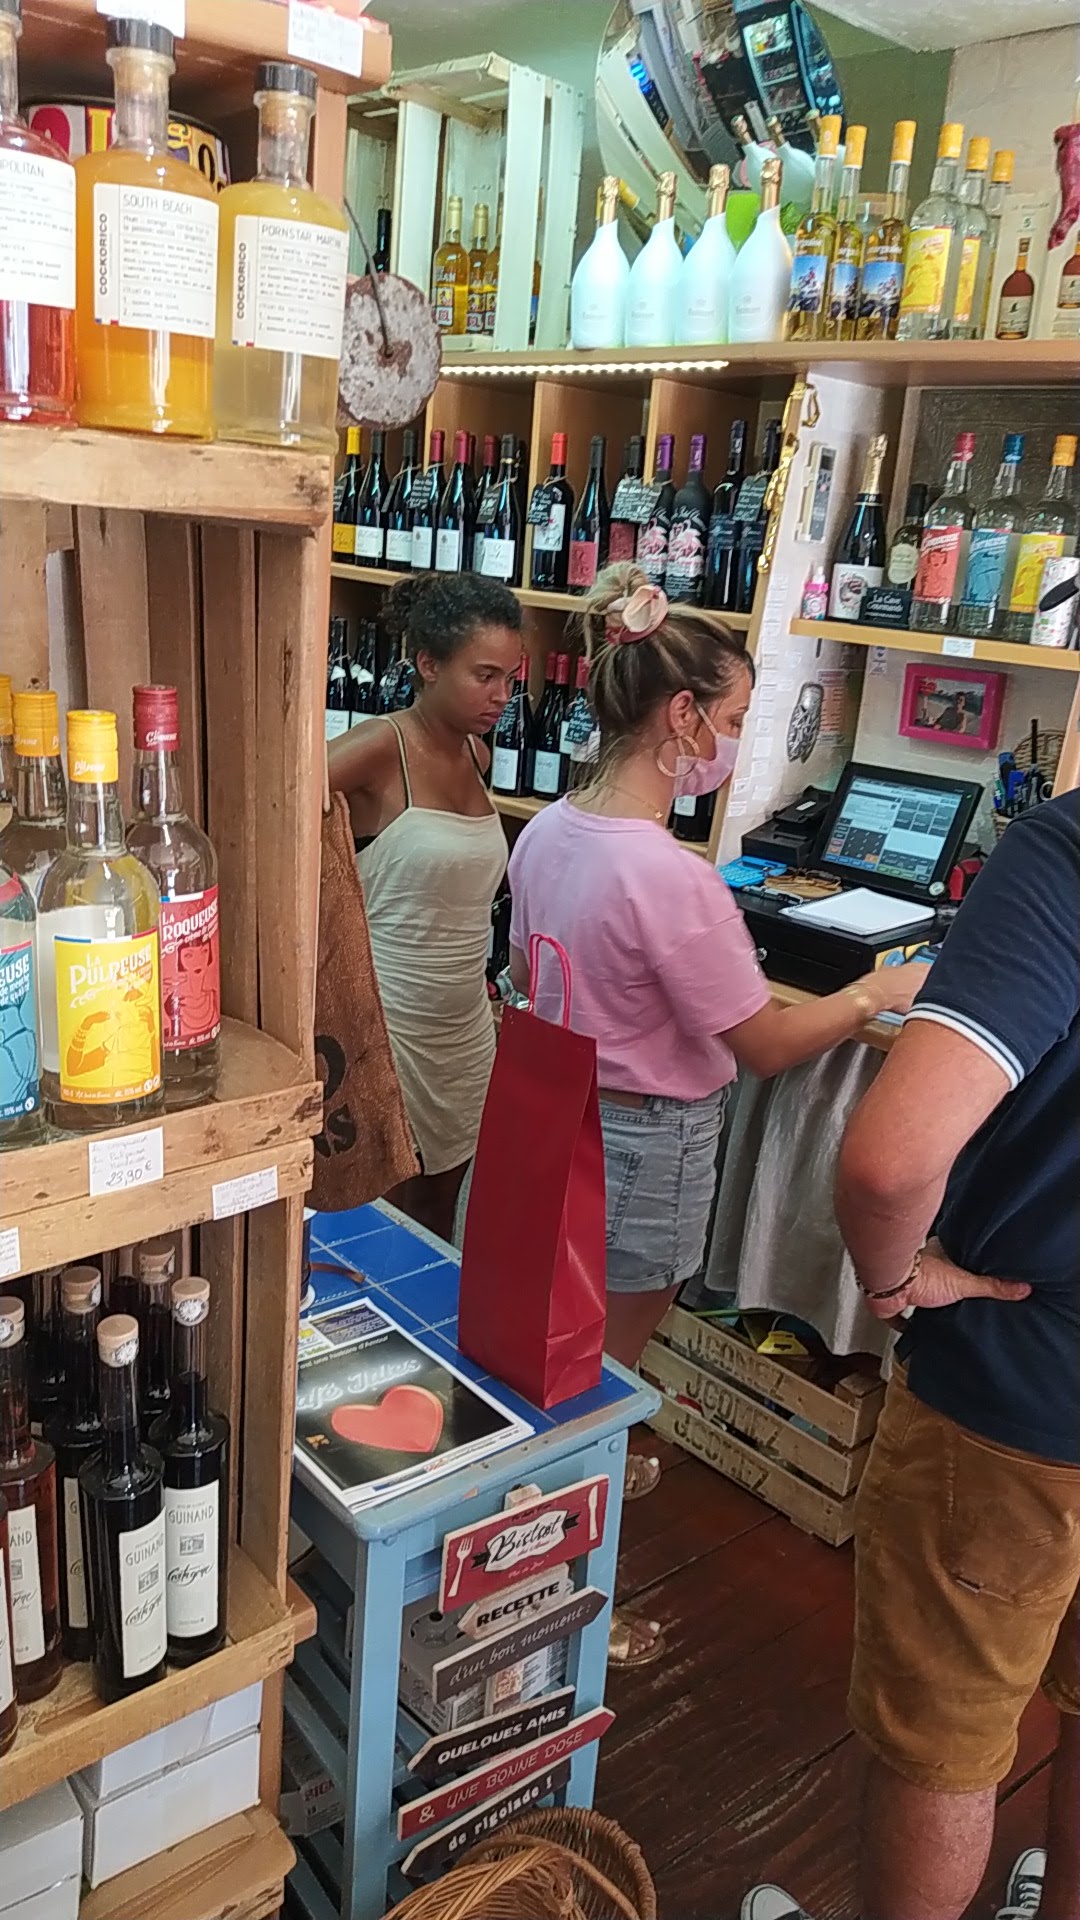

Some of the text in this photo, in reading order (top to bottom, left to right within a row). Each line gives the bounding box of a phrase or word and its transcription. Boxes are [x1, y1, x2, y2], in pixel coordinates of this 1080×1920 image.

[123, 193, 193, 215] SOUTH BEACH
[99, 213, 108, 296] COCKORICO
[261, 223, 312, 241] PORNSTAR
[236, 242, 247, 320] COCKORICO
[162, 911, 175, 926] LA
[69, 943, 153, 995] PULPEUSE
[86, 952, 101, 967] LA
[167, 1505, 215, 1524] GUINAND
[125, 1532, 165, 1567] GUINAND
[488, 1514, 562, 1564] Bistrot
[476, 1581, 560, 1628] RECETTE
[450, 1661, 485, 1687] d'un
[489, 1641, 516, 1666] bon
[525, 1706, 567, 1731] AMIS
[418, 1728, 585, 1824] & UNE BONNE DOSE
[448, 1774, 553, 1852] de rigolade !
